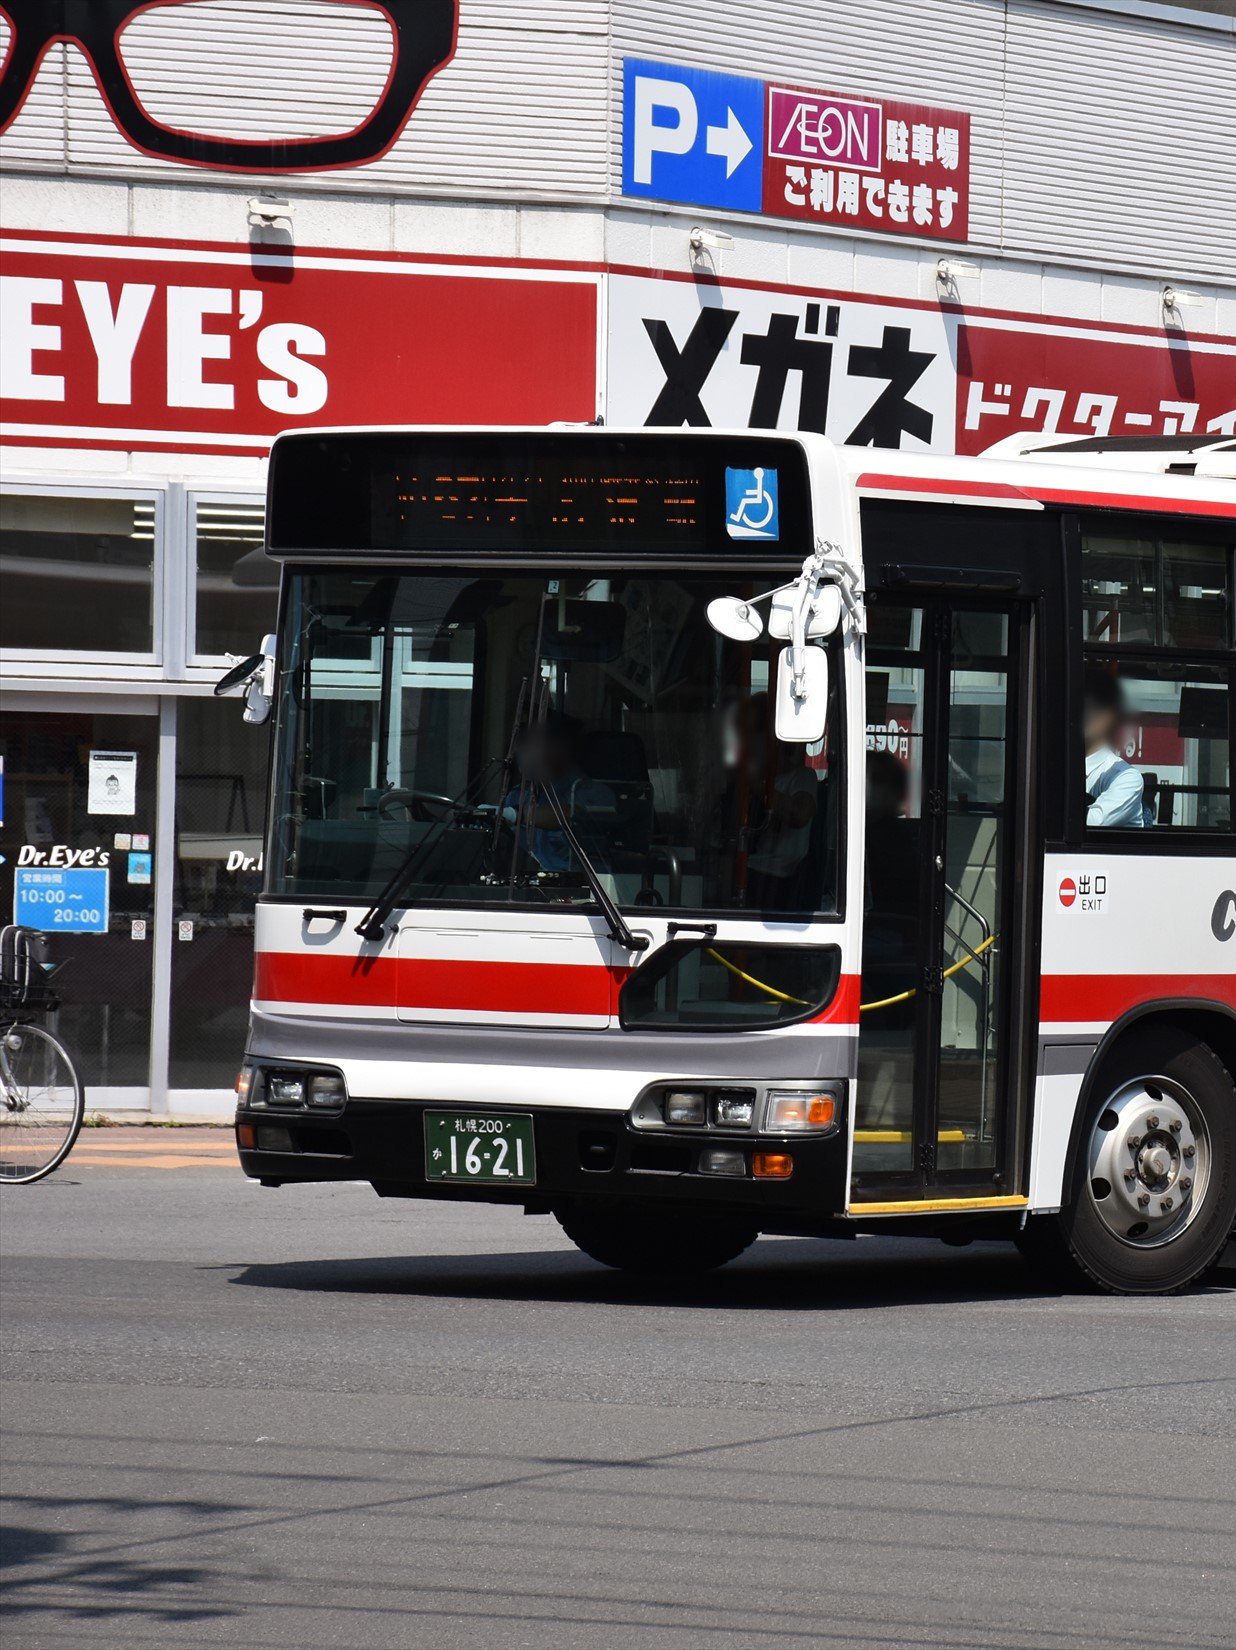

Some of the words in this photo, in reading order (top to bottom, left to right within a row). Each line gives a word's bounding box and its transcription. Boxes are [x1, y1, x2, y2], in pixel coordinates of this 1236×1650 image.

[634, 75, 698, 185] P
[886, 119, 959, 170] 駐車場
[784, 164, 958, 229] ご利用できます
[0, 275, 328, 415] EYE's
[641, 302, 938, 450] メガネ
[17, 844, 110, 869] Dr.Eye's
[1078, 874, 1107, 895] 出口
[54, 908, 100, 923] 20:00
[1081, 899, 1103, 911] EXIT
[455, 1119, 503, 1133] 札幌200
[432, 1147, 442, 1160] か
[450, 1136, 524, 1176] 16-21
